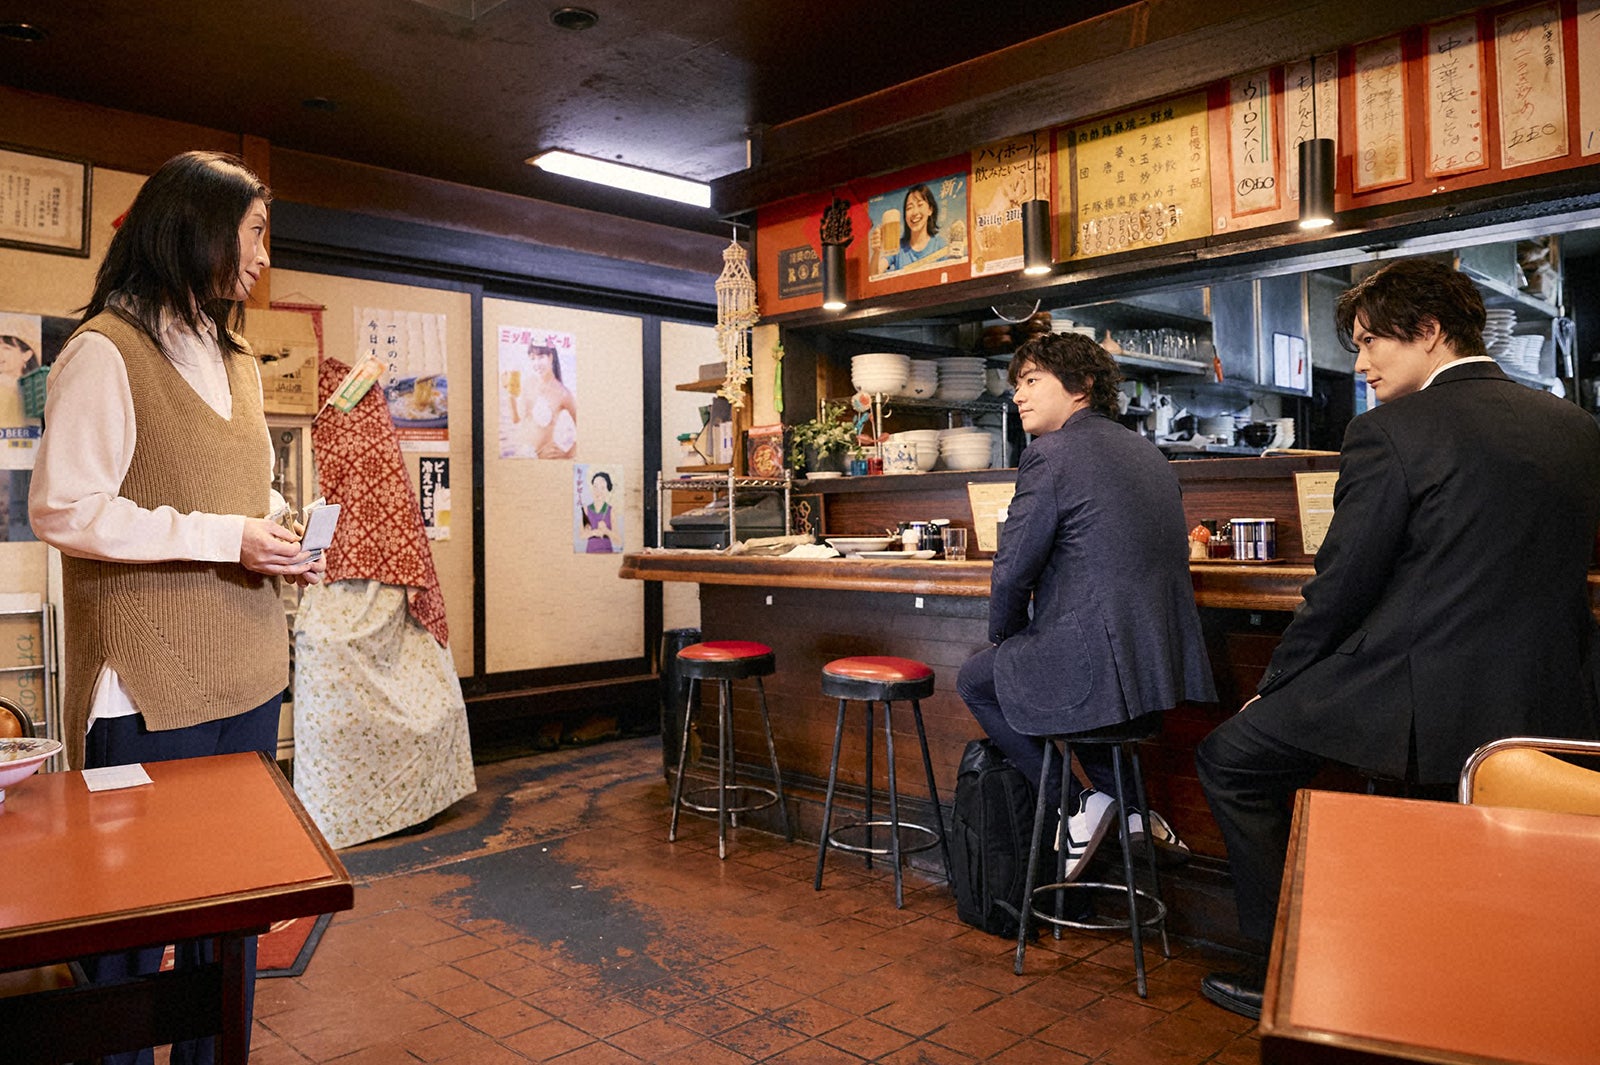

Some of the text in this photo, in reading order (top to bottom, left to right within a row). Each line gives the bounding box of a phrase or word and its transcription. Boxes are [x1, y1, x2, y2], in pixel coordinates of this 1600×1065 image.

[1432, 36, 1467, 147] 中華焼きそば
[1242, 80, 1259, 165] ウーロンハイ
[979, 142, 1042, 163] ハイボール
[1189, 125, 1203, 189] 自慢の一品
[978, 214, 1002, 227] Billy
[546, 334, 571, 348] ビール
[5, 428, 30, 438] BEER
